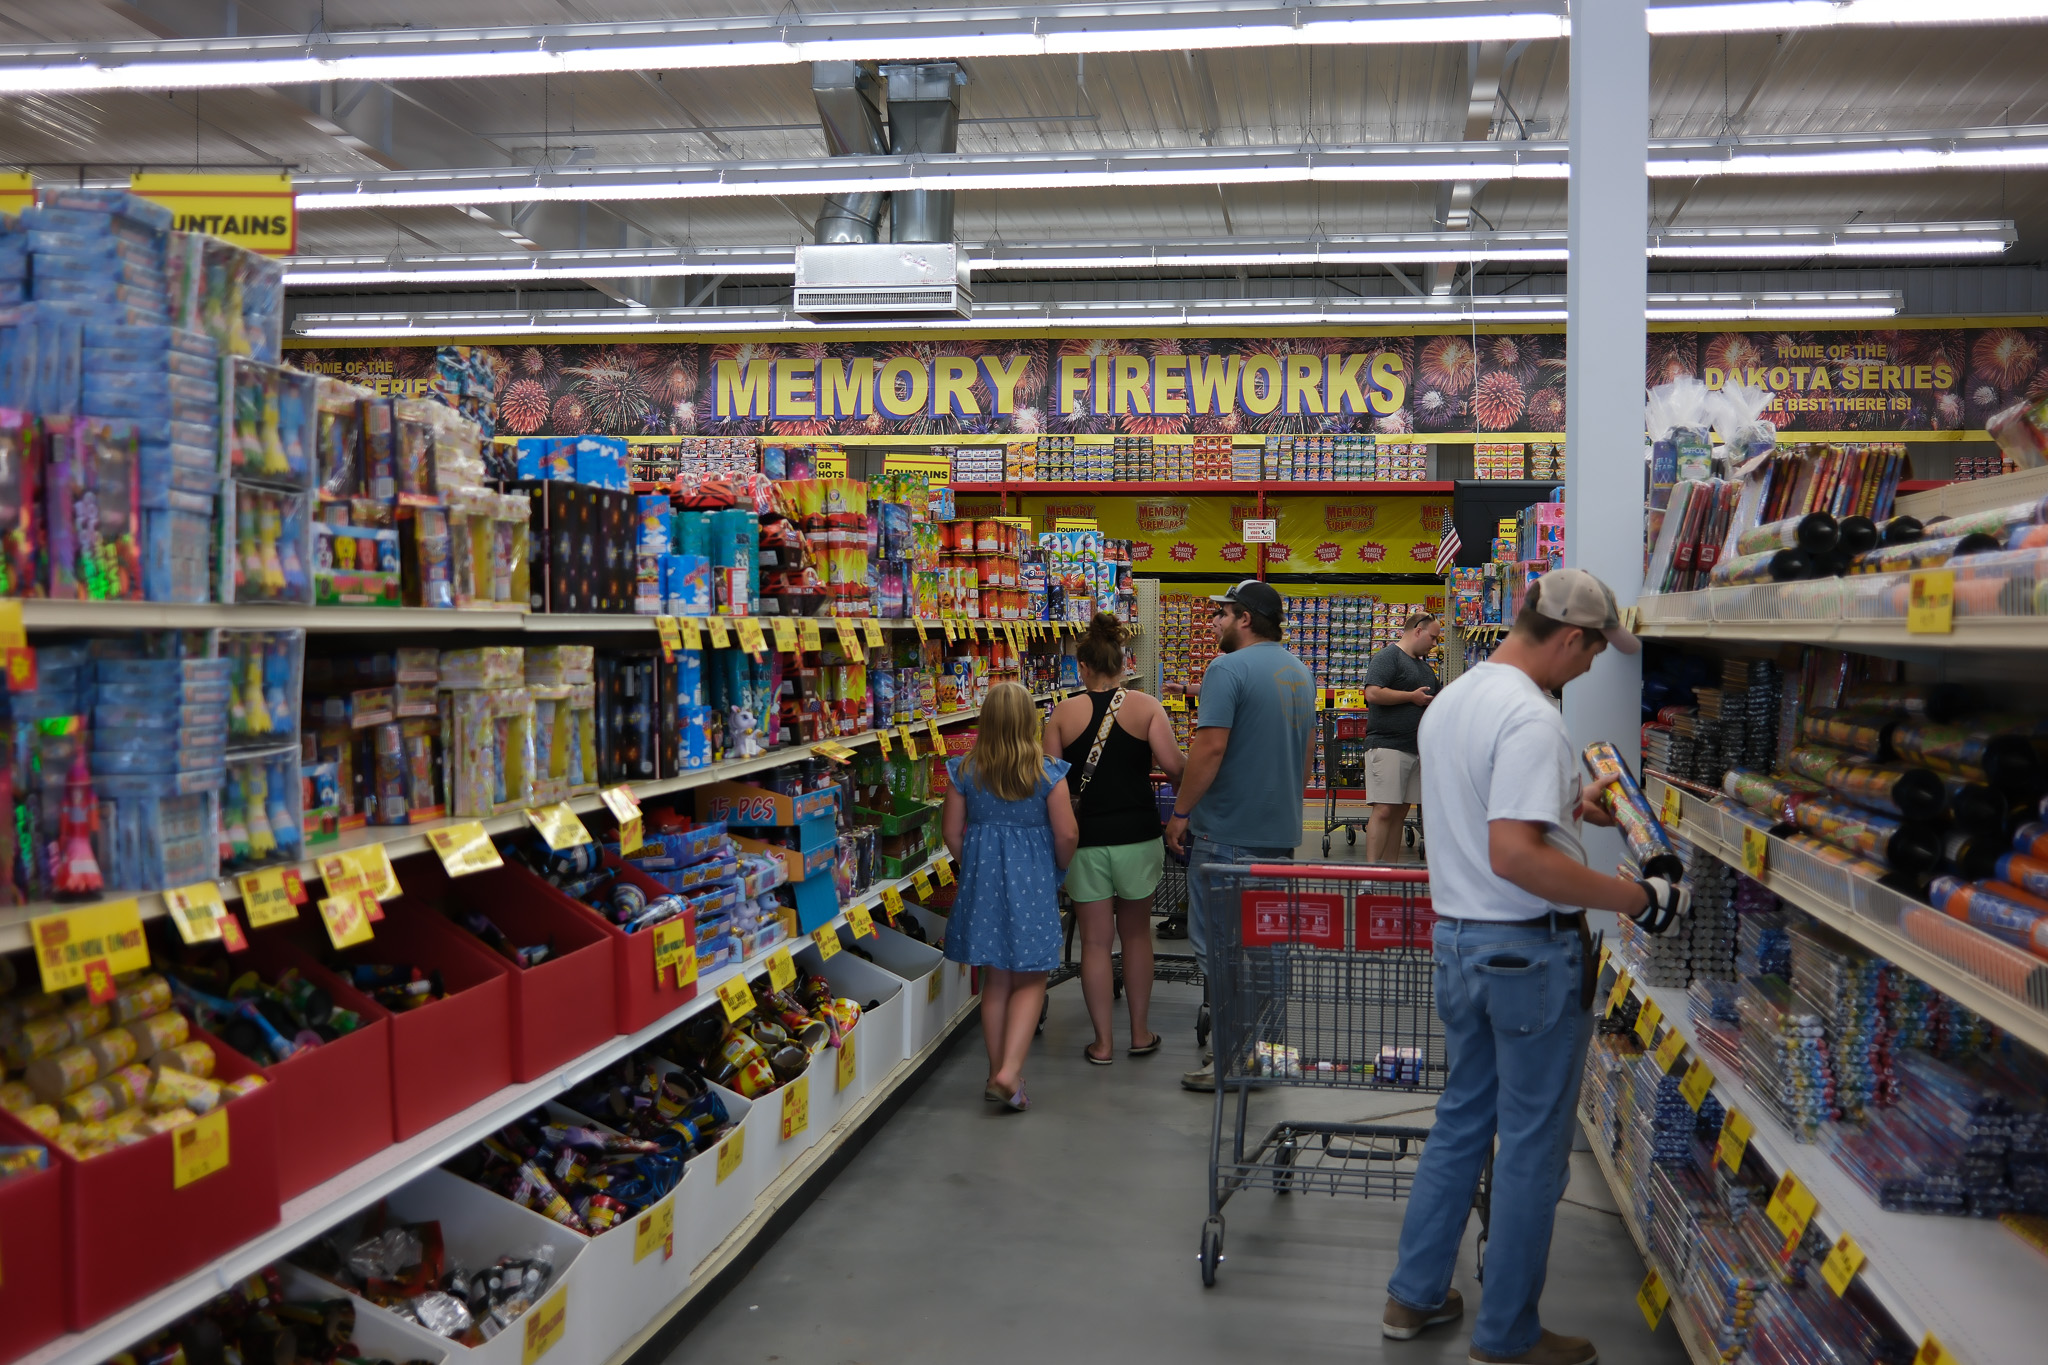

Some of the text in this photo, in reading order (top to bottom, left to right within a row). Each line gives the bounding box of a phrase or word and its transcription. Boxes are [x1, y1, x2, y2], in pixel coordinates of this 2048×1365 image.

[171, 214, 287, 235] UNTAINS
[1777, 344, 1887, 359] HOME OF THE
[303, 361, 393, 374] HOME OF THE
[1704, 365, 1953, 391] DAKOTA SERIES
[711, 352, 1406, 421] MEMORY FIREWORKS
[1787, 398, 1827, 412] BEST
[1835, 397, 1886, 412] THERE
[1891, 397, 1912, 411] IS!
[818, 461, 832, 469] GR
[816, 471, 844, 479] HOTS
[1138, 505, 1188, 518] MEMORY
[1231, 505, 1280, 518] MEMRY
[1326, 505, 1375, 518] MEMORY
[1138, 518, 1184, 531] FIREWORKS
[1326, 518, 1374, 531] FIREWORKS
[711, 796, 775, 821] 15 PCS
